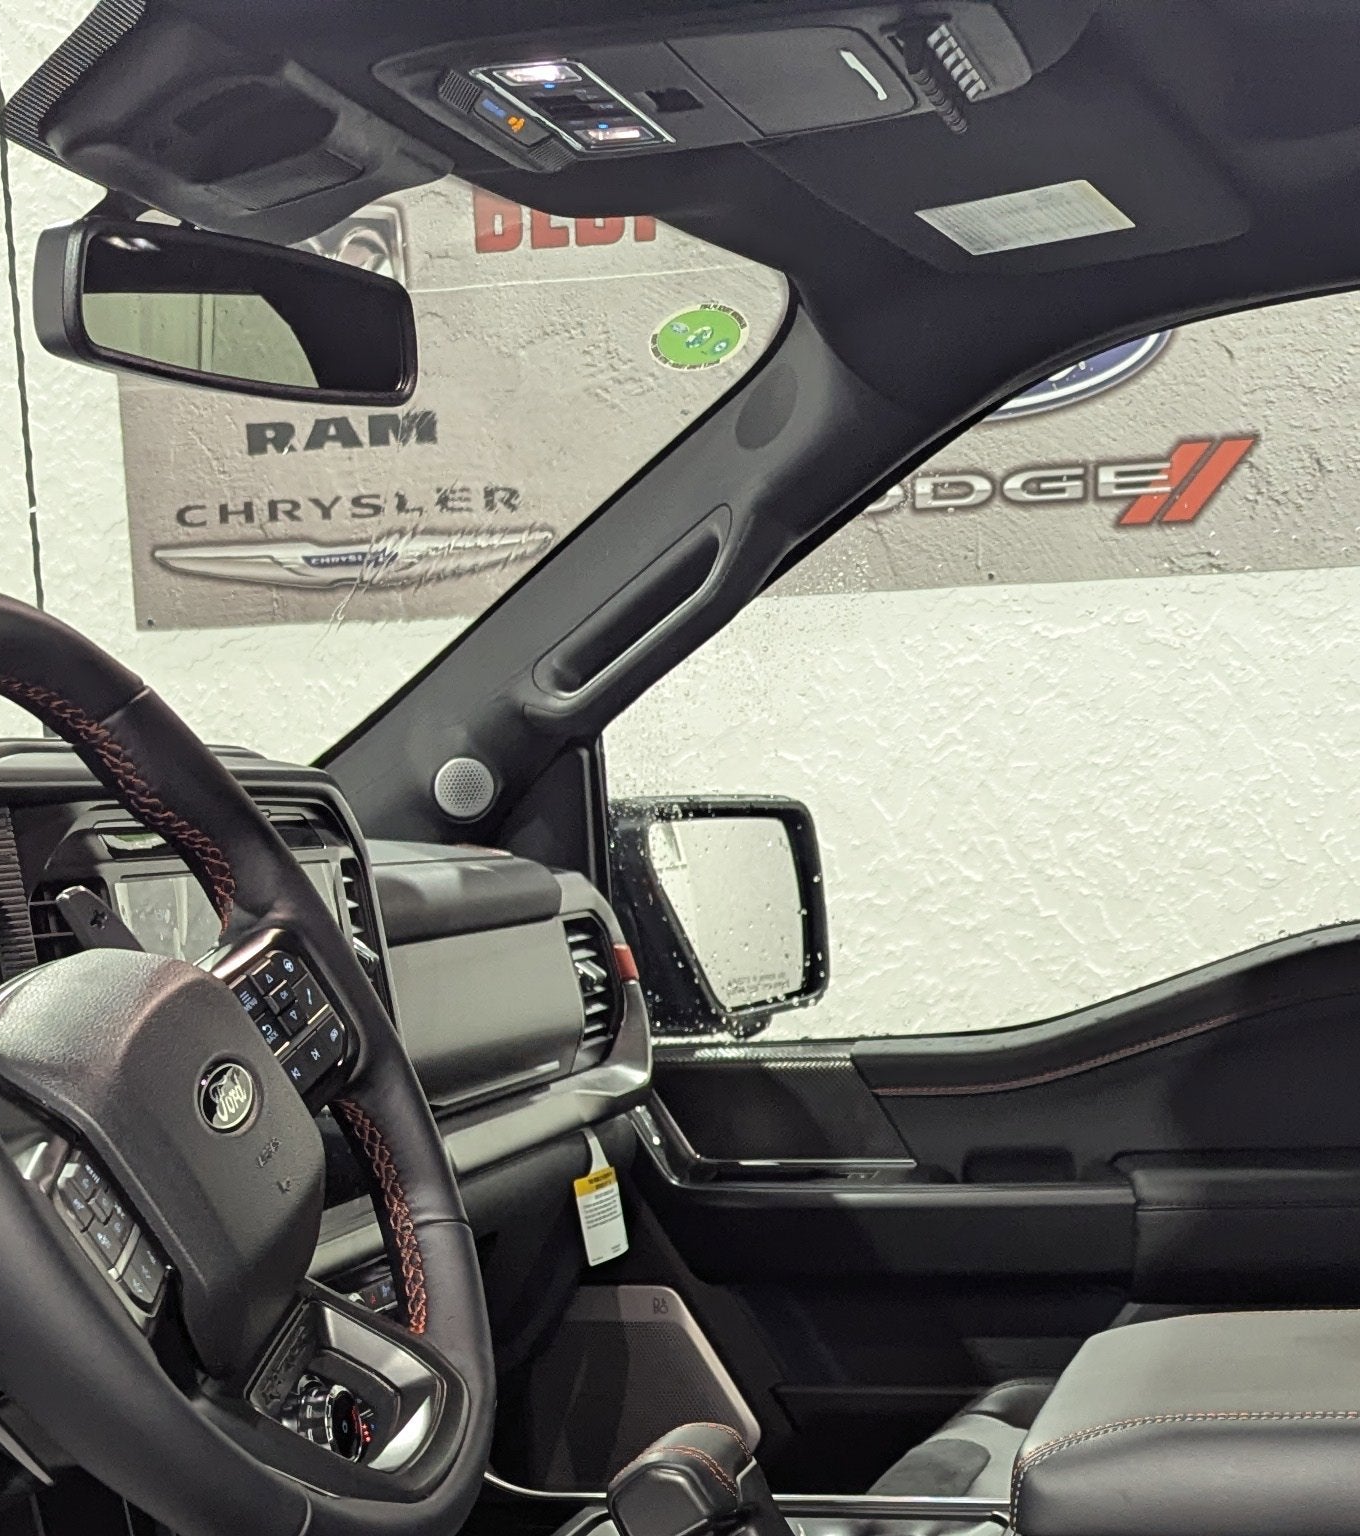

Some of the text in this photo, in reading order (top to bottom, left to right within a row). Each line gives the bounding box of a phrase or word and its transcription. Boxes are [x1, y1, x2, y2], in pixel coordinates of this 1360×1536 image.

[246, 410, 438, 456] RAM
[176, 487, 521, 528] CHRYSLER
[865, 462, 1172, 512] DGE
[209, 1068, 247, 1122] Ford
